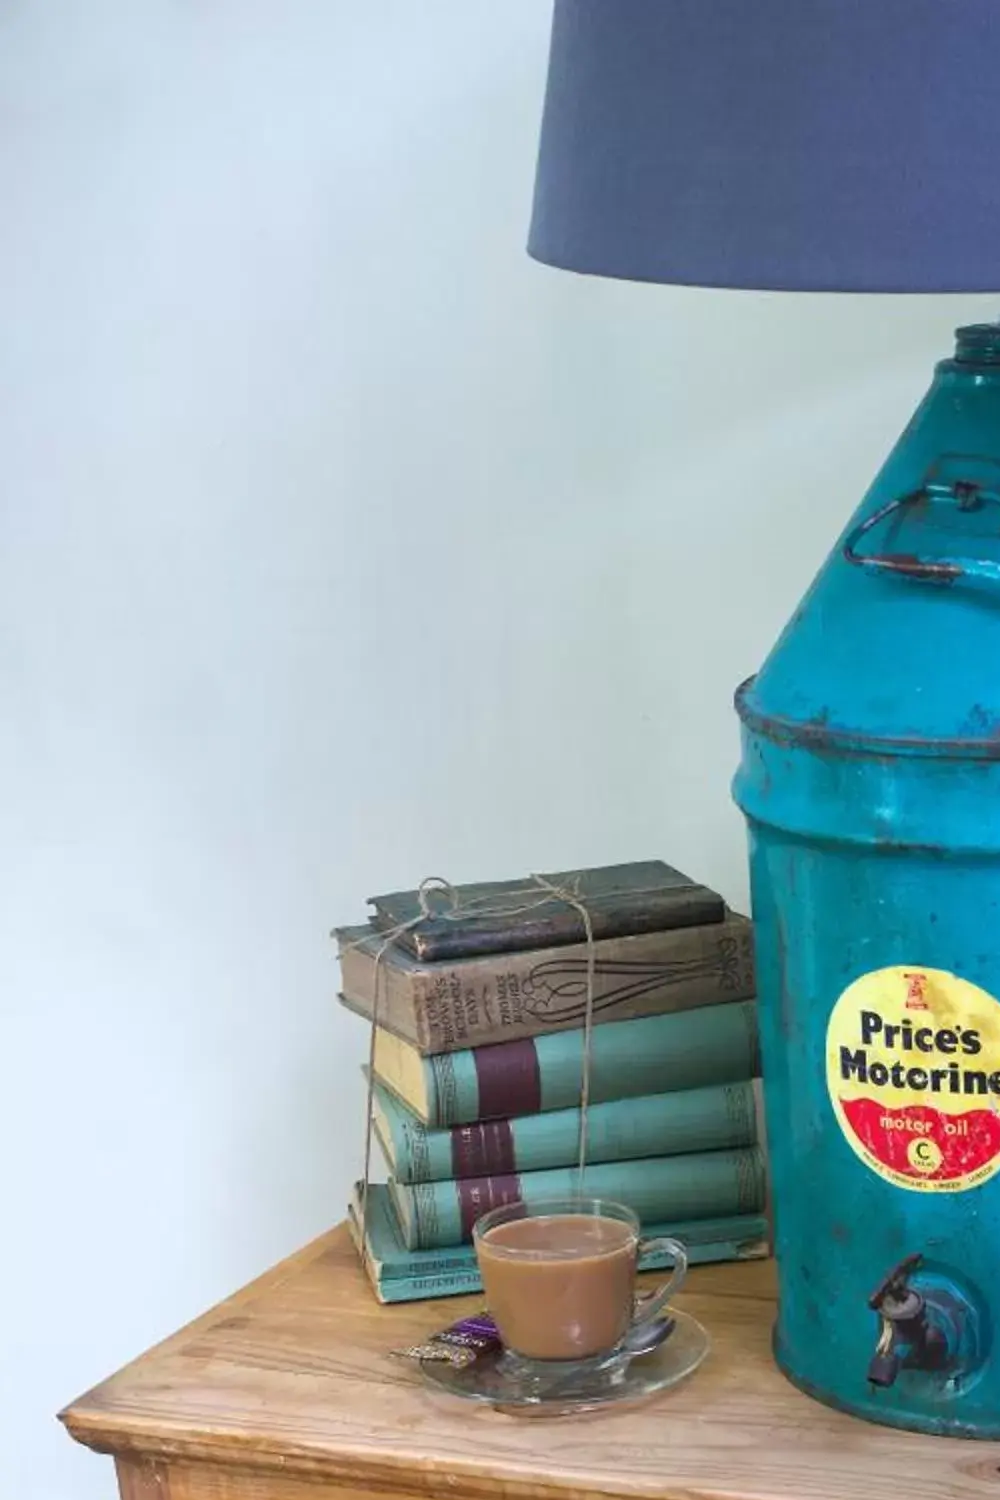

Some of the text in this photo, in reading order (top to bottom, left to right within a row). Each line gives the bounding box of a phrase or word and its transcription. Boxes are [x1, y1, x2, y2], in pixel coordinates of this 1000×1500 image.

[860, 1010, 982, 1054] Price's
[880, 1116, 968, 1136] motor oil
[916, 1142, 931, 1160] C
